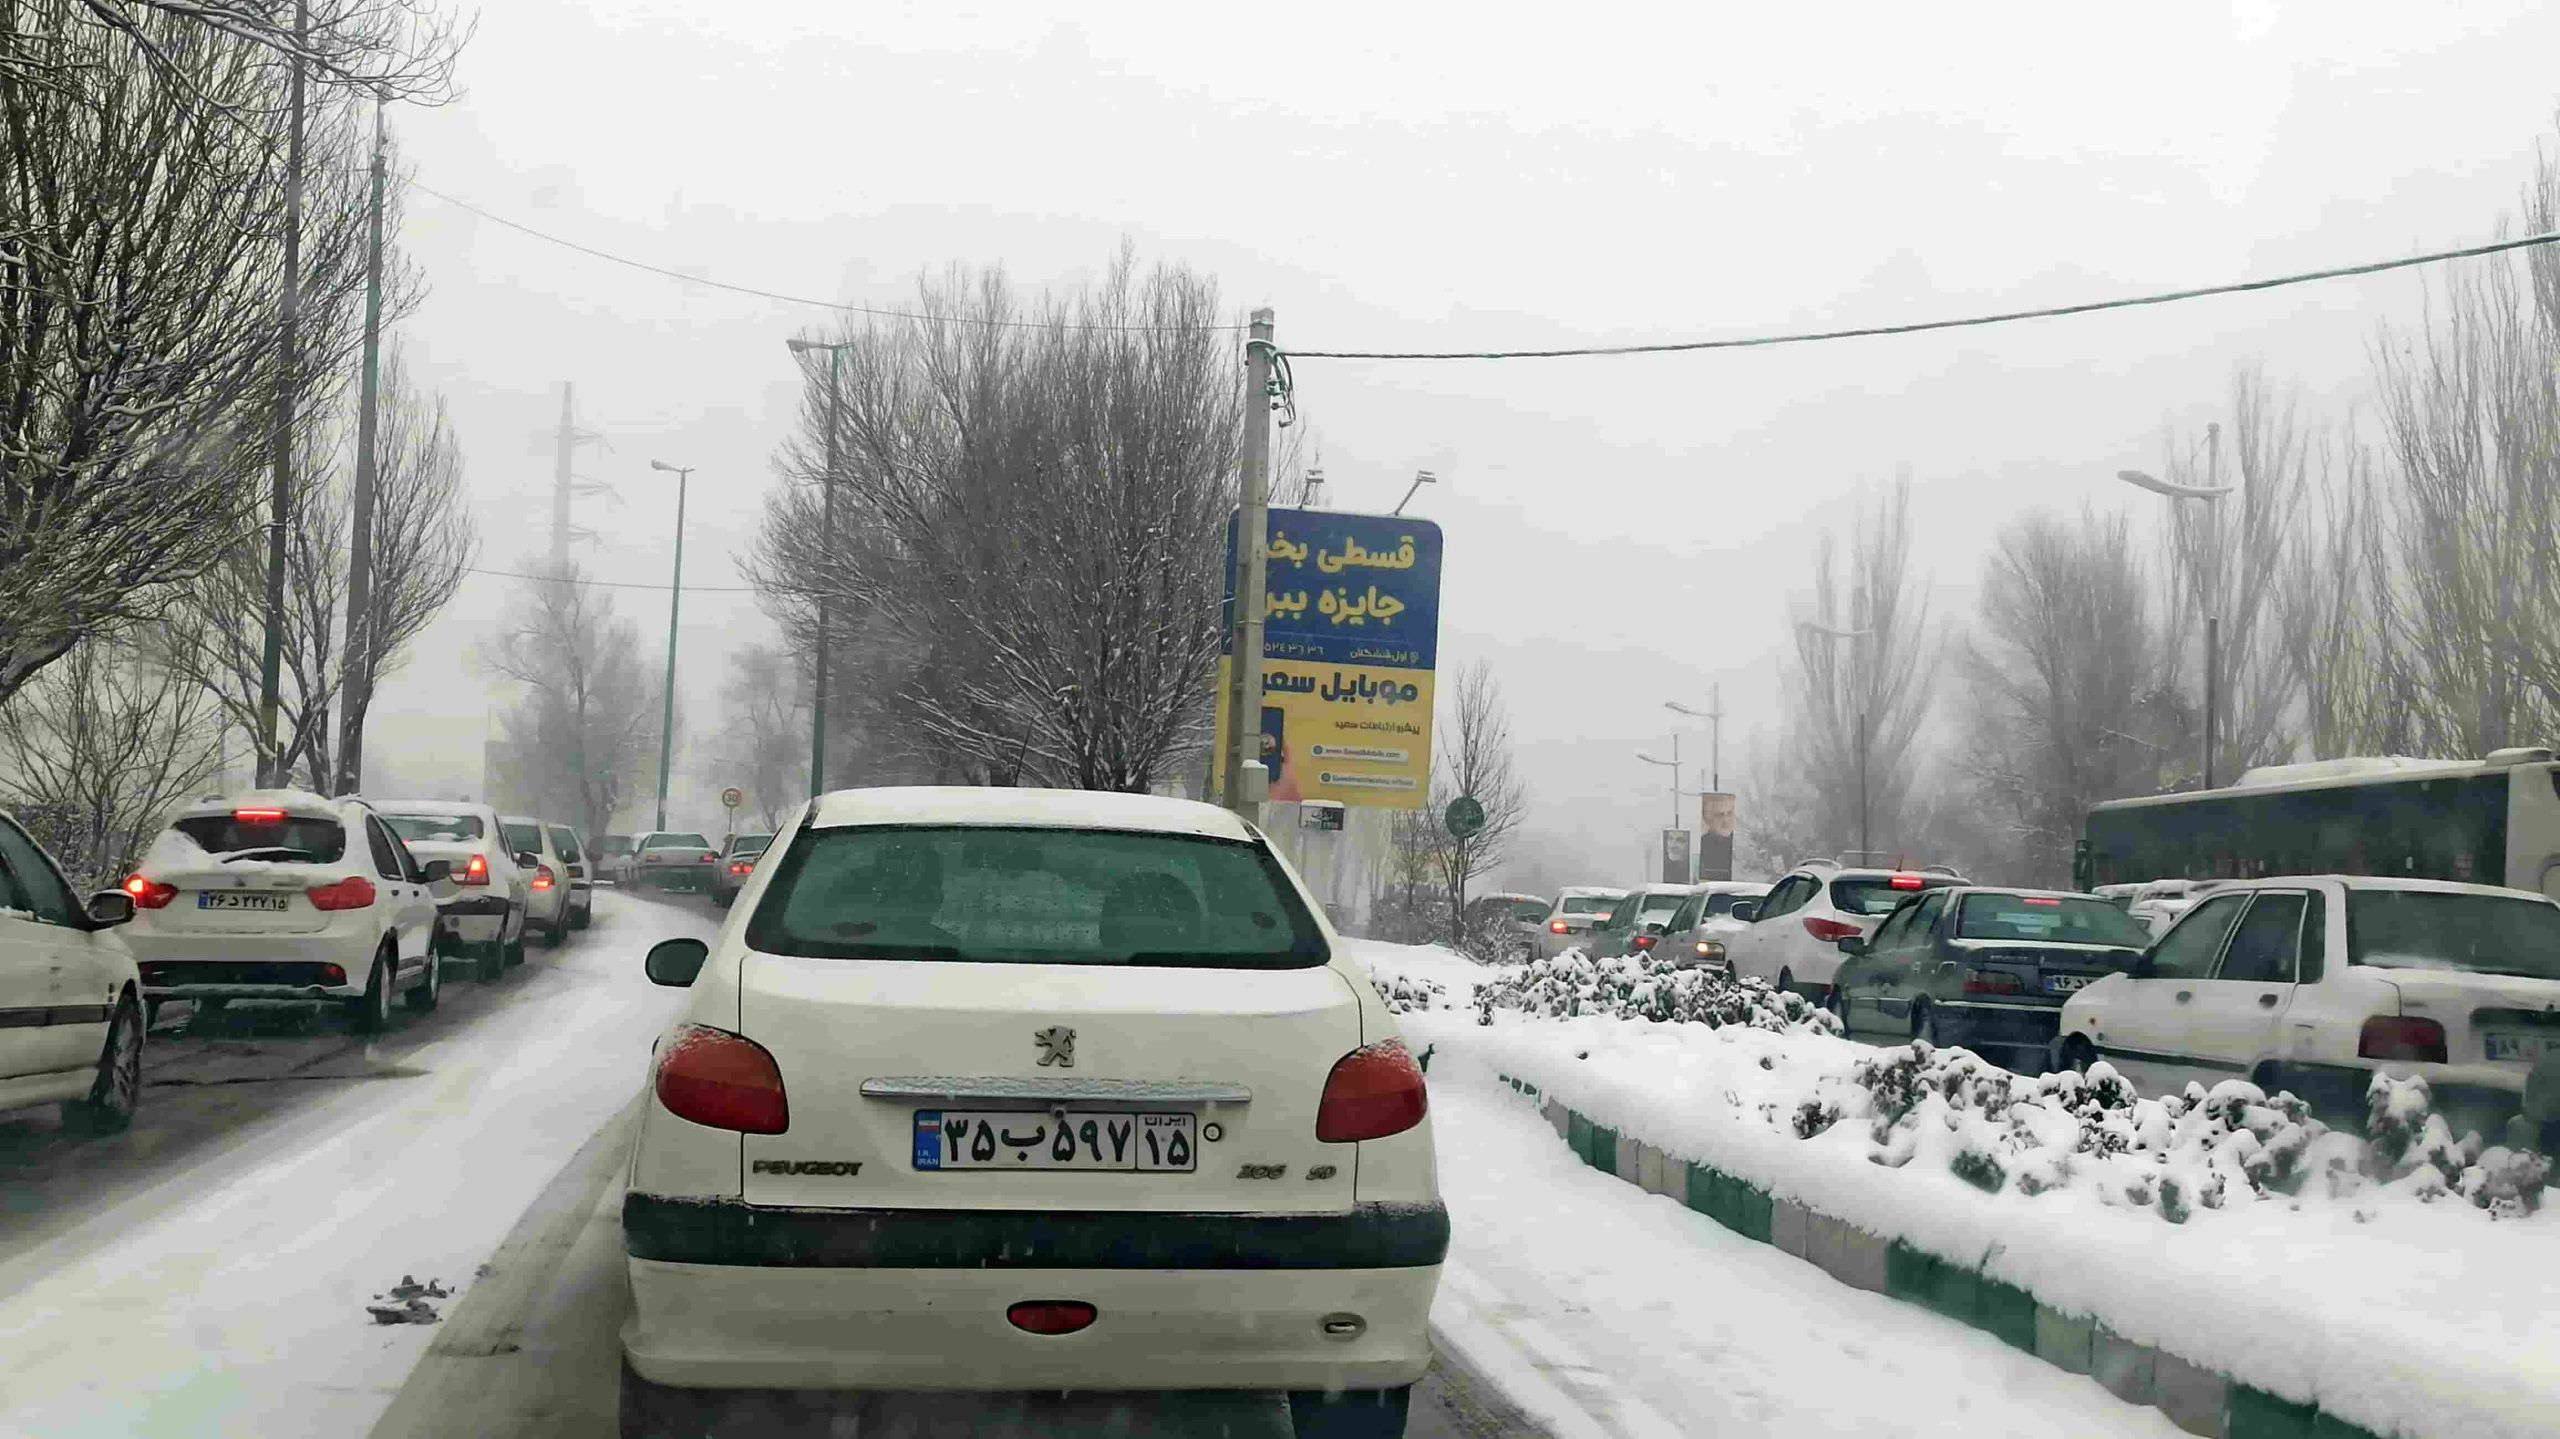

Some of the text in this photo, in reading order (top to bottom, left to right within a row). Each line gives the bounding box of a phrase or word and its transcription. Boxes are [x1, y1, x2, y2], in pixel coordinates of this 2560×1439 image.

[1264, 530, 1415, 574] قسطی بخ
[1317, 585, 1405, 625] جایزه
[1321, 672, 1418, 705] موبایل
[1144, 1116, 1186, 1126] ایران
[1145, 1128, 1190, 1166] ۱۵
[752, 1160, 863, 1176] PEUGEOT
[917, 1157, 939, 1166] IRAN
[1236, 1163, 1287, 1180] 206
